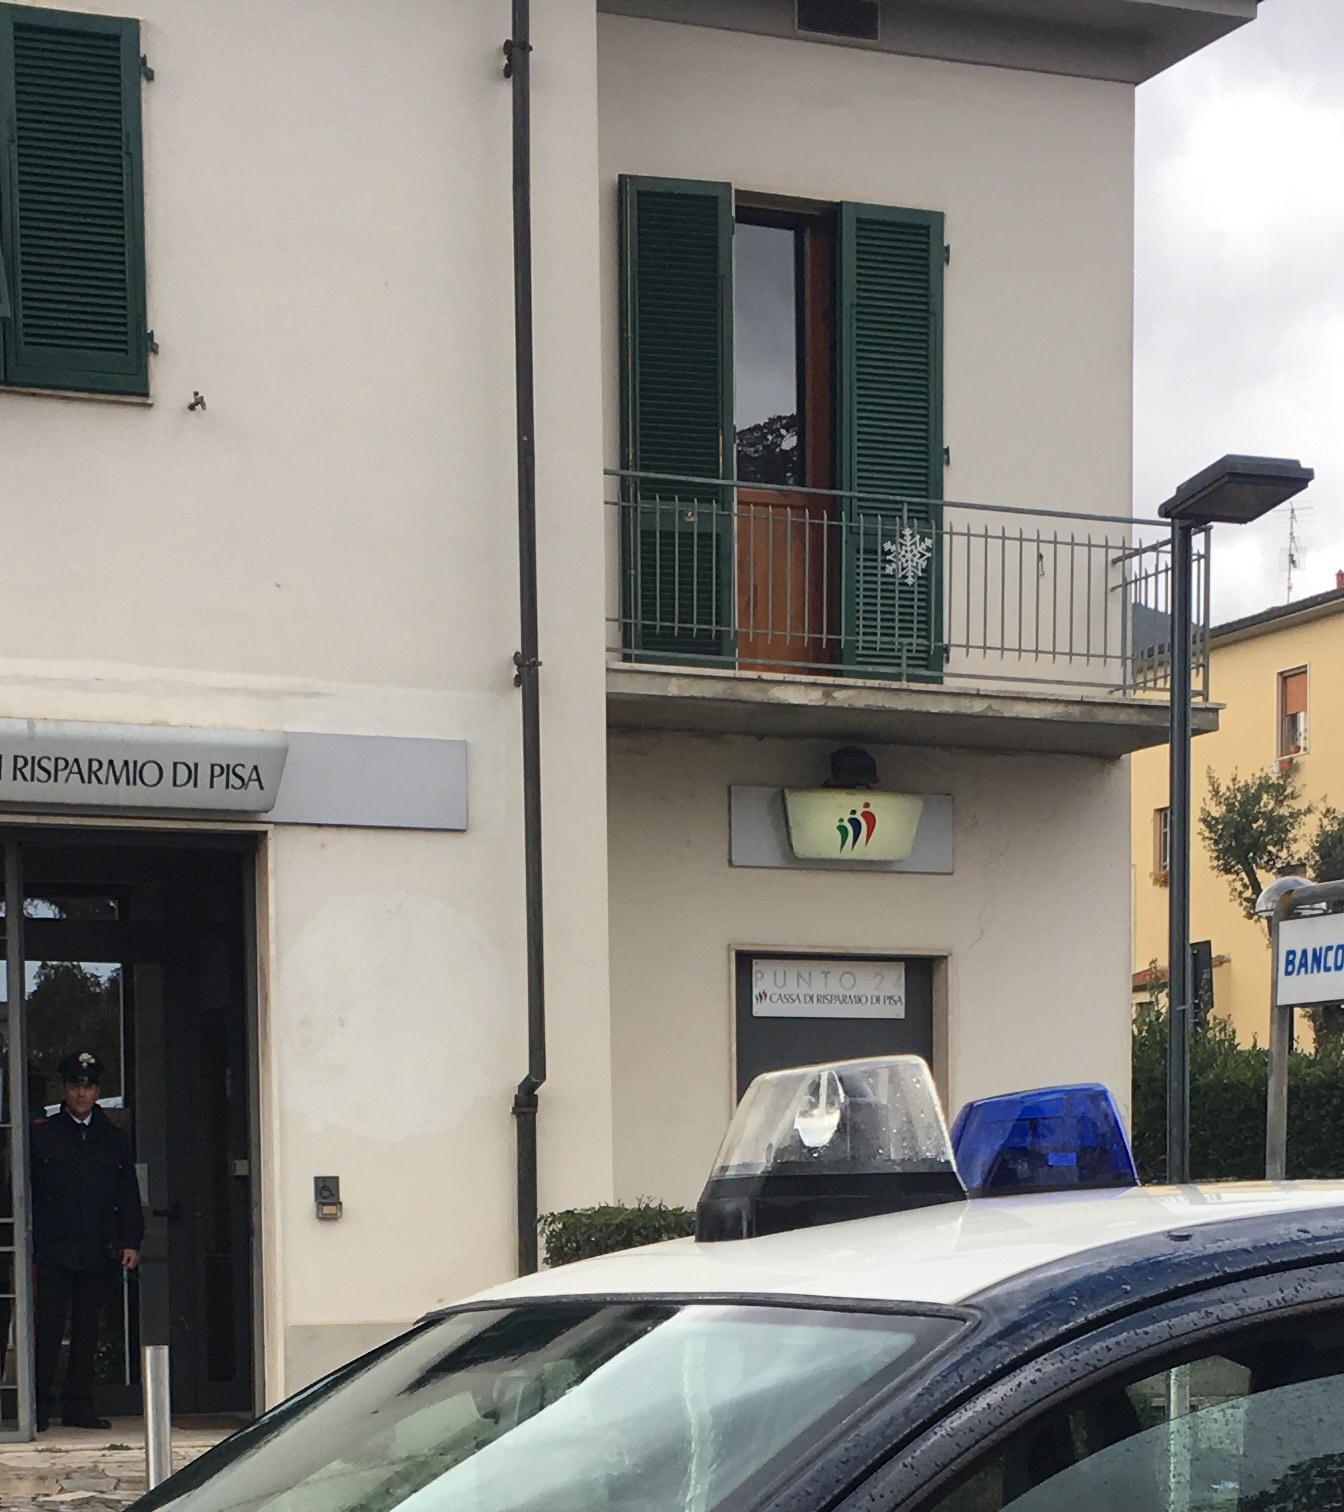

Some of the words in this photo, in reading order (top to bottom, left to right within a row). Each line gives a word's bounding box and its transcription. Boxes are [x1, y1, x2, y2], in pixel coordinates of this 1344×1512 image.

[11, 755, 164, 788] RISPARMIO
[172, 761, 199, 788] DI
[209, 763, 265, 791] PISA
[755, 970, 857, 990] PUNTO
[770, 993, 801, 1005] CASSA
[804, 994, 814, 1005] DI
[816, 994, 868, 1006] RISPARMIO
[870, 995, 881, 1006] DI
[883, 995, 903, 1007] PISA
